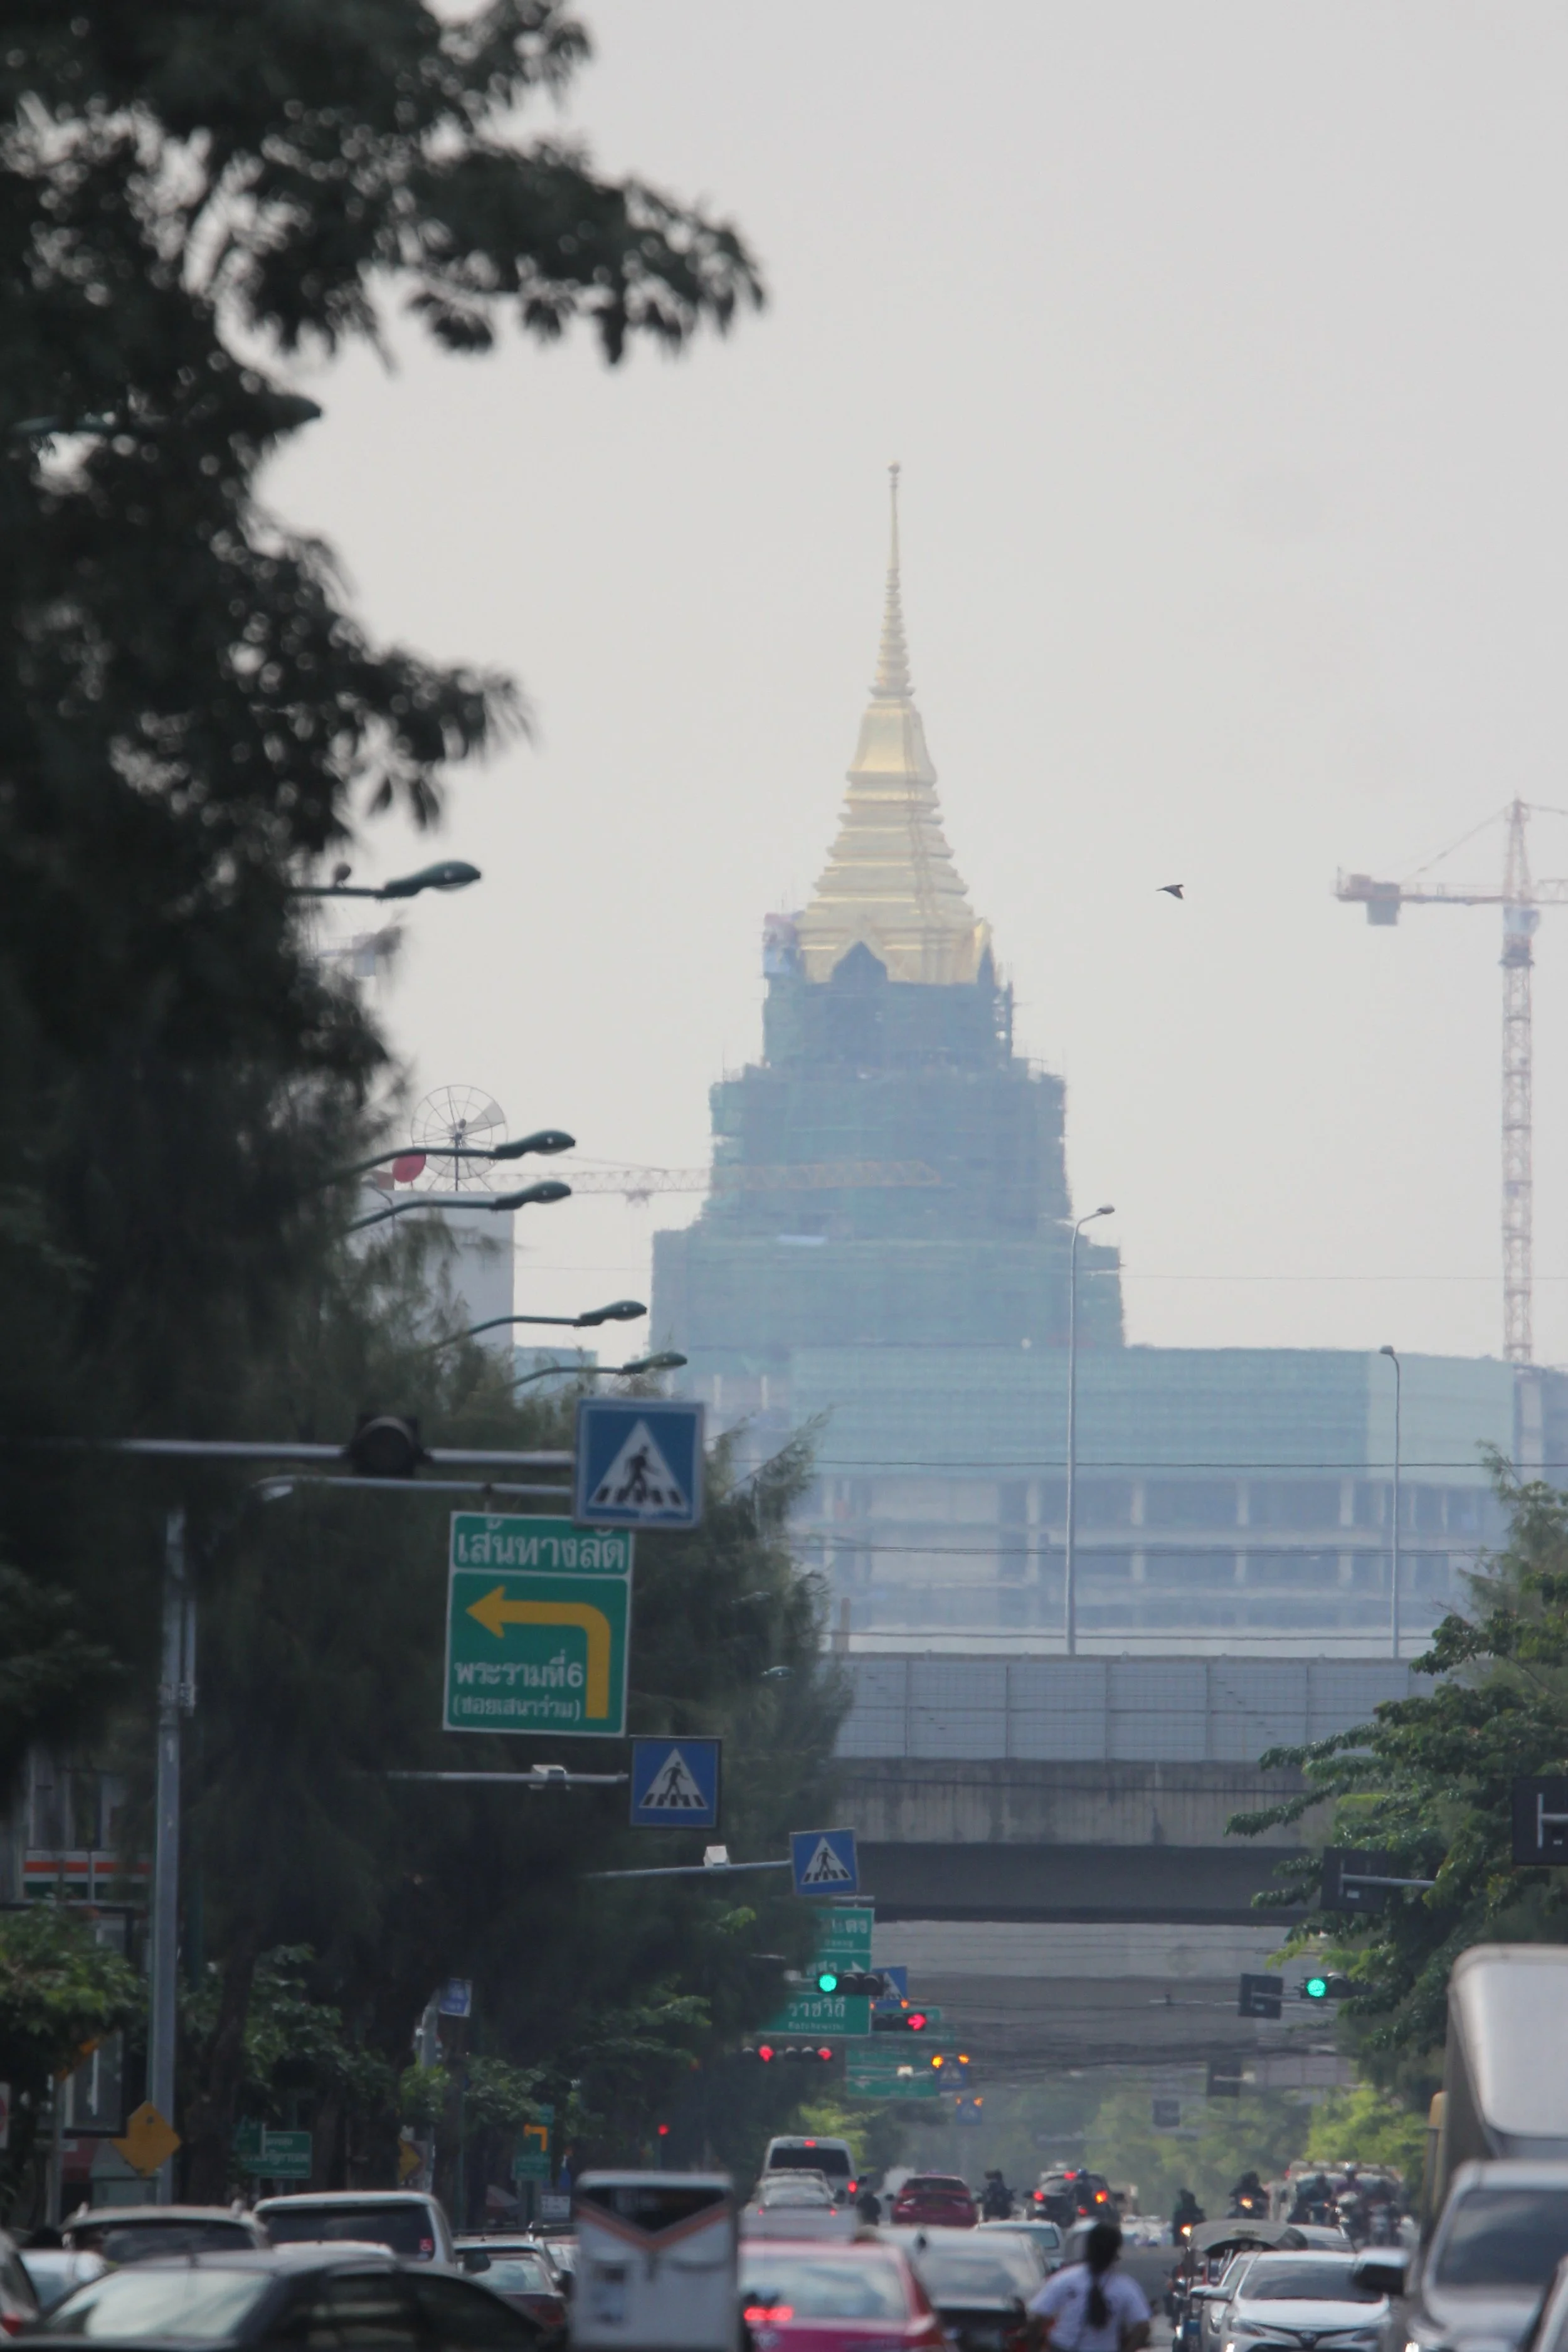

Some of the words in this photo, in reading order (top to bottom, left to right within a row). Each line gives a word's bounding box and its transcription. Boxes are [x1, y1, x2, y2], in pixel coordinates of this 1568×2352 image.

[457, 1518, 625, 1569] เส้นทางลัด
[788, 1996, 845, 2018] ราชวิถี
